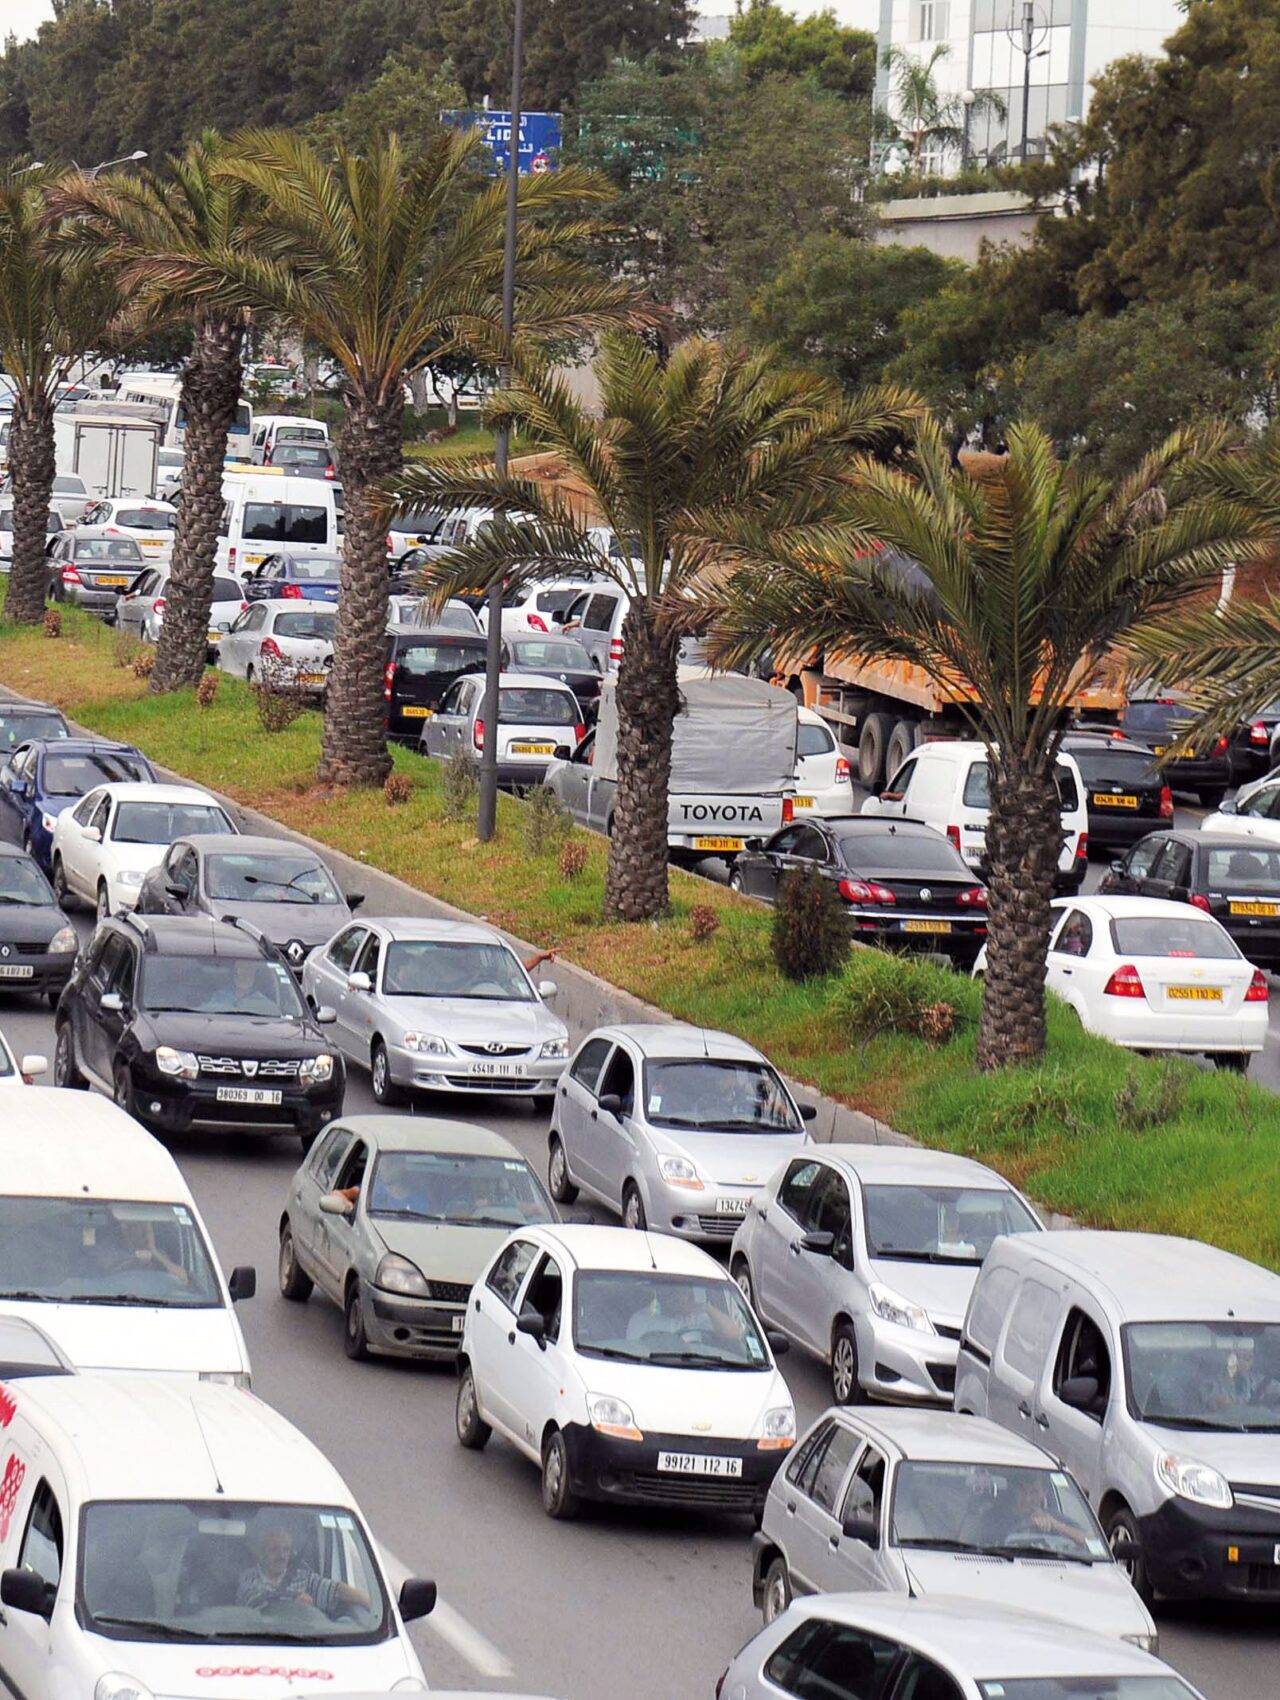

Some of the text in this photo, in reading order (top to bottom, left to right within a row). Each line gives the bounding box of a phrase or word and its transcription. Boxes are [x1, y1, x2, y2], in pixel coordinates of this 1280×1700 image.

[680, 804, 763, 821] TOYOTA
[664, 1455, 737, 1474] 99121 112 16
